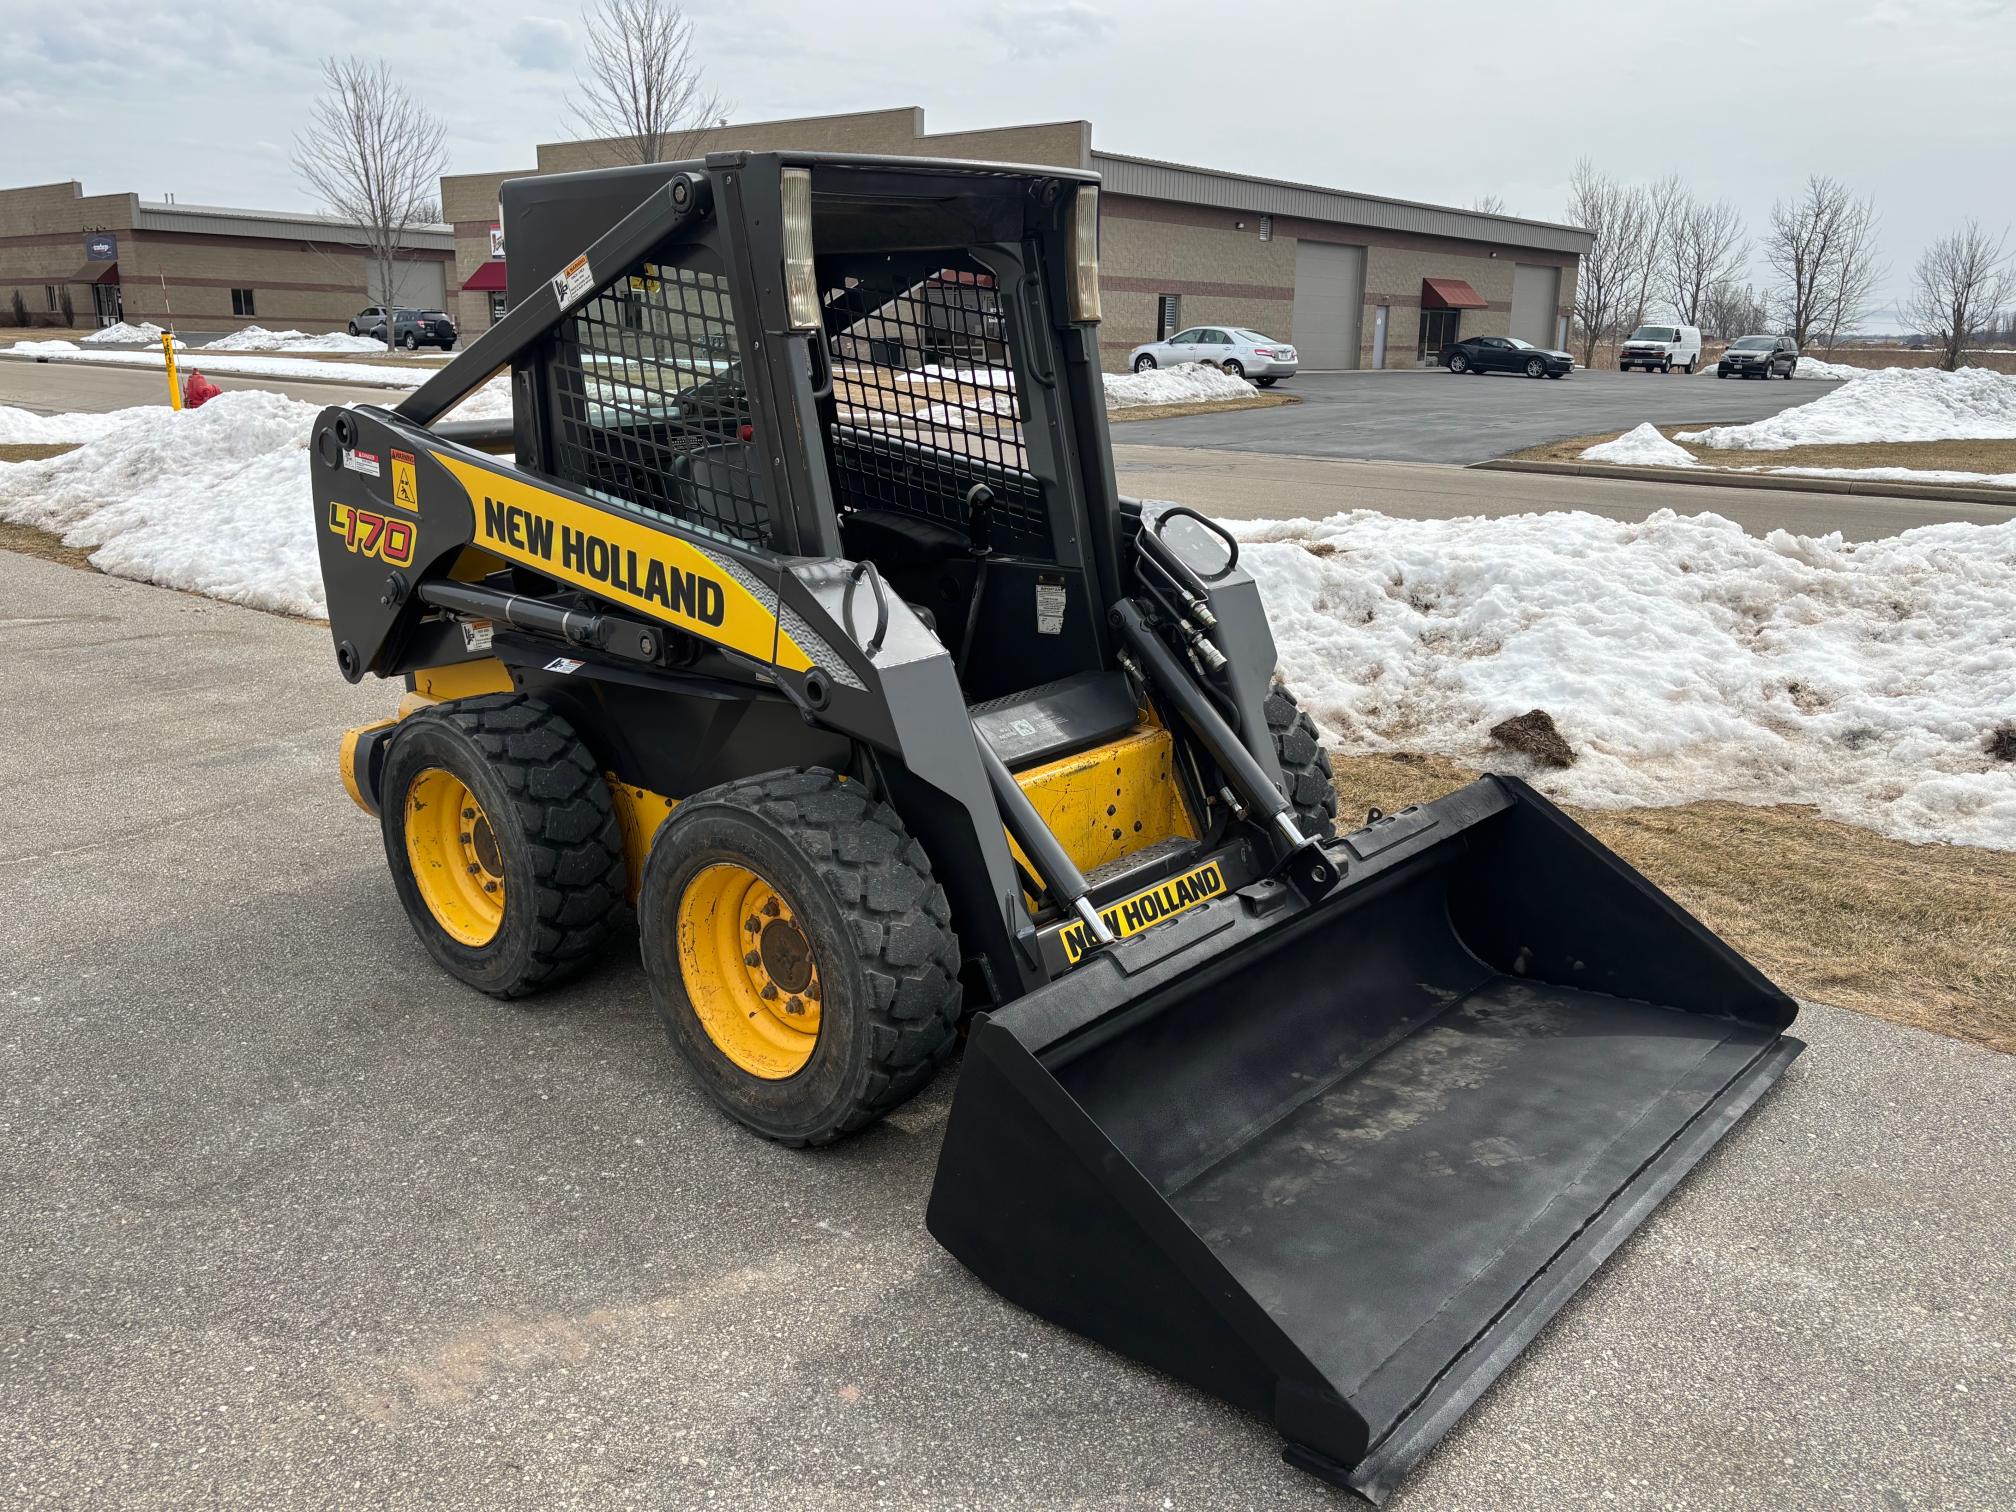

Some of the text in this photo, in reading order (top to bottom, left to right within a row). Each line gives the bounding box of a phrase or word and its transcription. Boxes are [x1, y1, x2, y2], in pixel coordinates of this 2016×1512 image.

[330, 503, 413, 562] L170
[484, 496, 724, 627] NEW HOLLAND
[1122, 866, 1221, 932] HOLLAND
